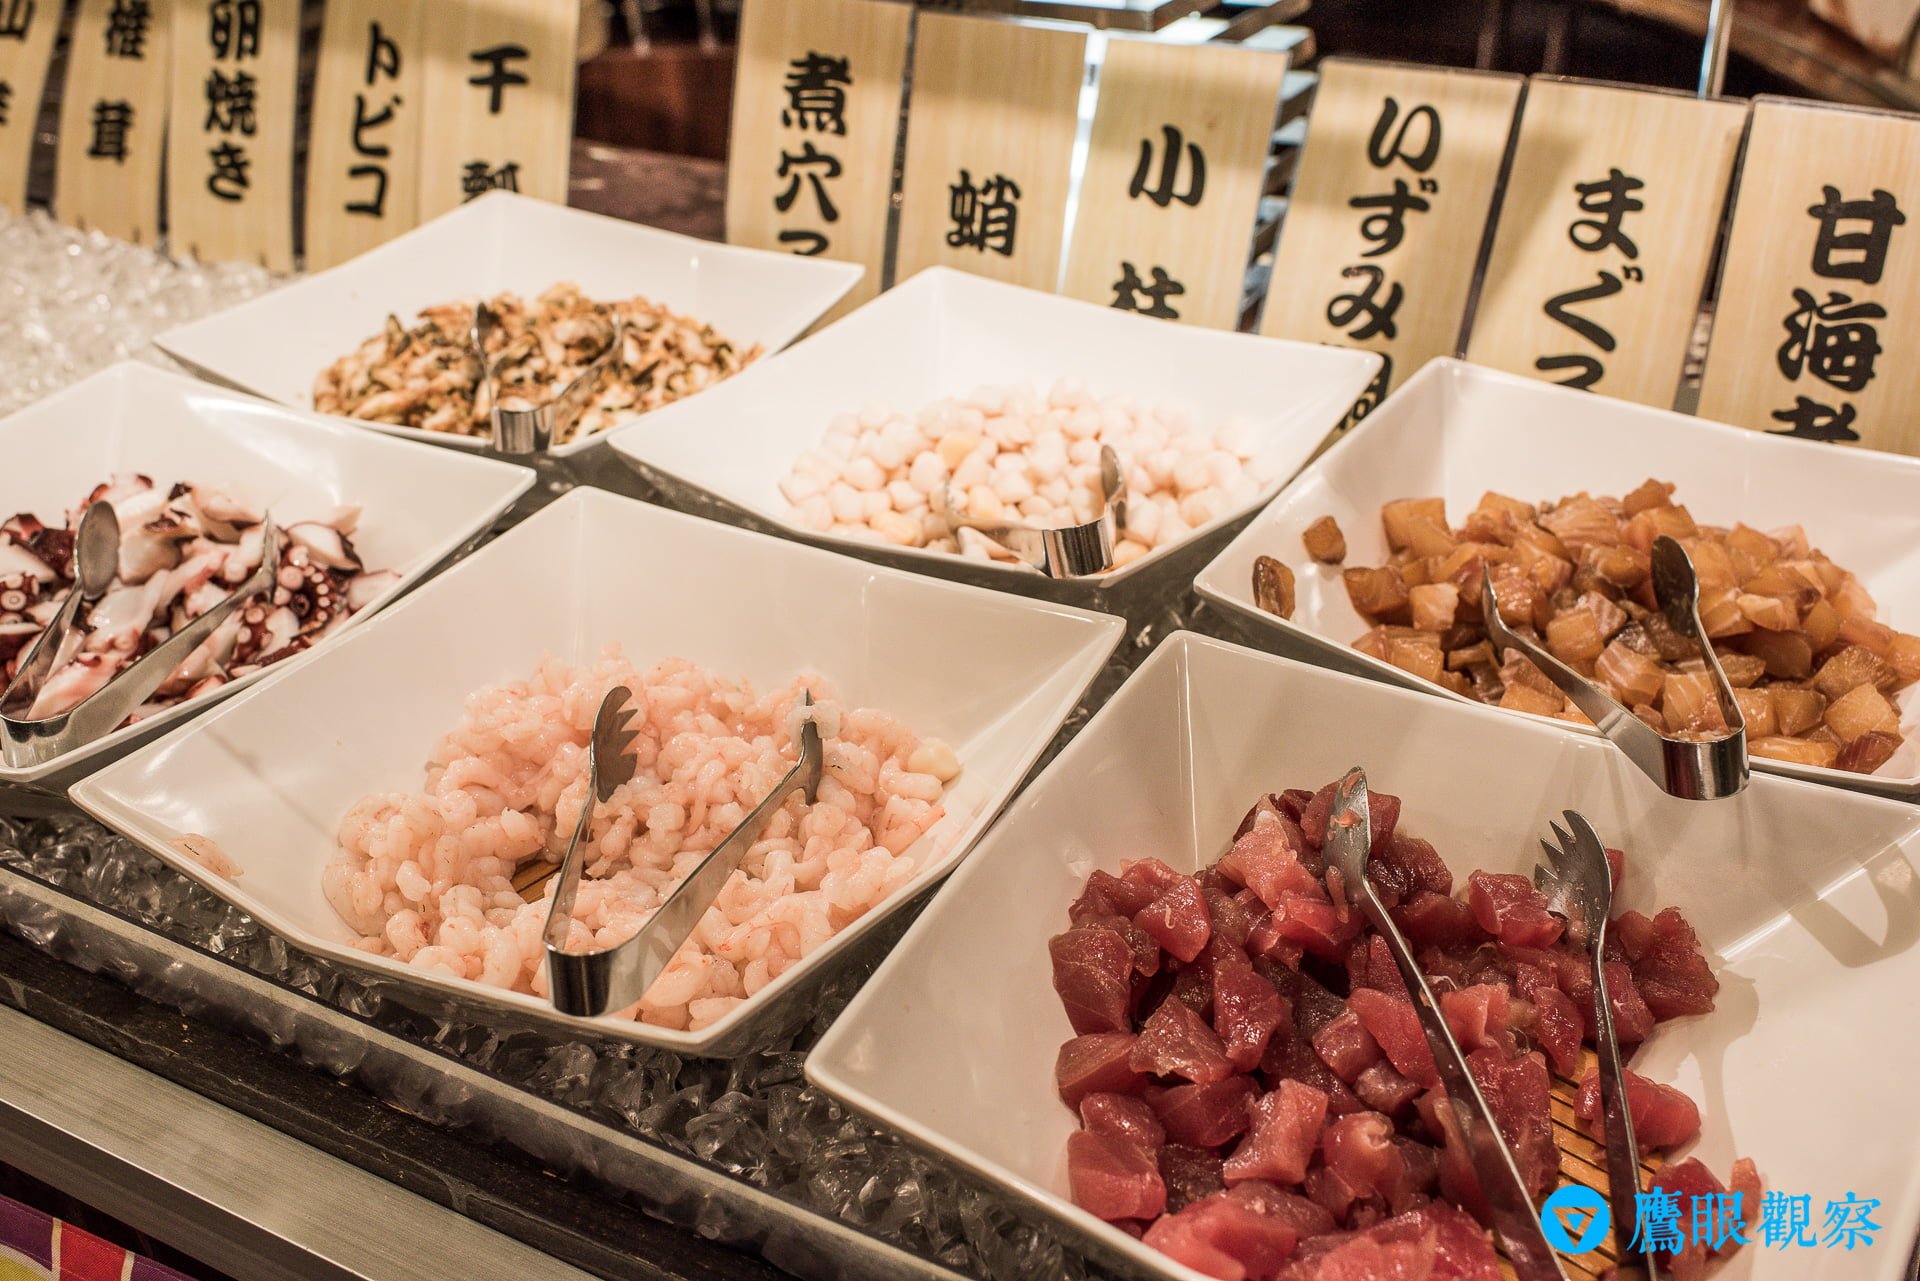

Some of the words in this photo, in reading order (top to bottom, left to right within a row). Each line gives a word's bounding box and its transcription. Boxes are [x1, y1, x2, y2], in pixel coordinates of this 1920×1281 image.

[205, 0, 262, 201] 卵焼き
[345, 20, 403, 218] トビコ
[946, 168, 1022, 257] 蛸
[1322, 96, 1441, 430] いずみ
